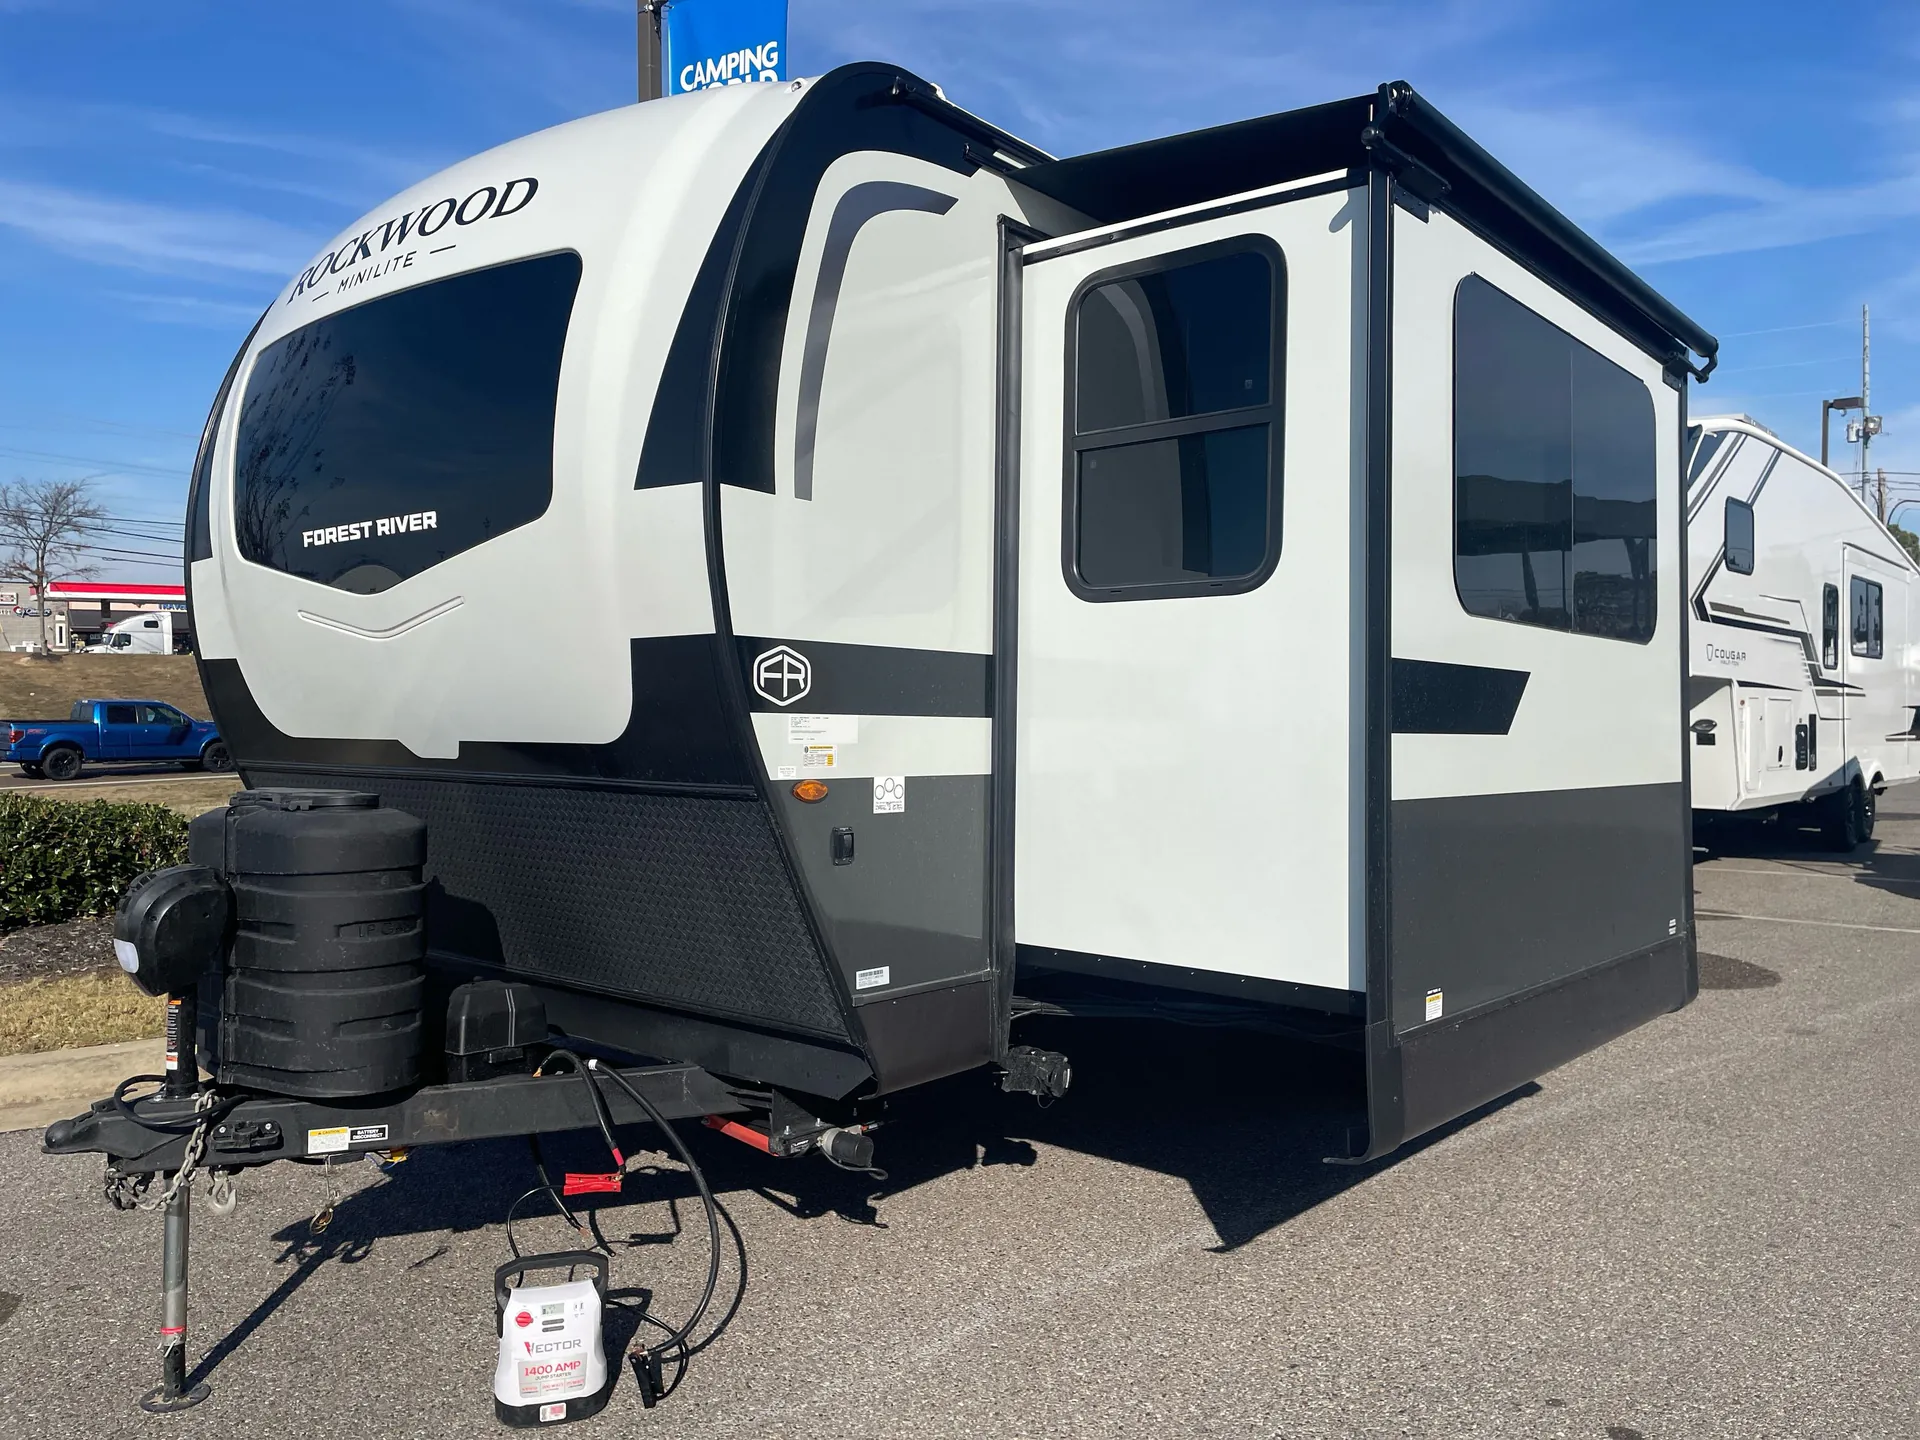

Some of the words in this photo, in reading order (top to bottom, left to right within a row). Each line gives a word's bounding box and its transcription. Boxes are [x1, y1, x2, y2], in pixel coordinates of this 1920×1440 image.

[680, 41, 778, 92] CAMPING
[286, 177, 539, 305] ROCKWOOD
[337, 251, 417, 294] MINILITE
[302, 521, 372, 548] FOREST
[376, 511, 437, 536] RIVER
[1715, 648, 1746, 661] COUGAR
[524, 1339, 582, 1358] VECTOR
[525, 1365, 553, 1376] 1400
[555, 1361, 581, 1372] AMP
